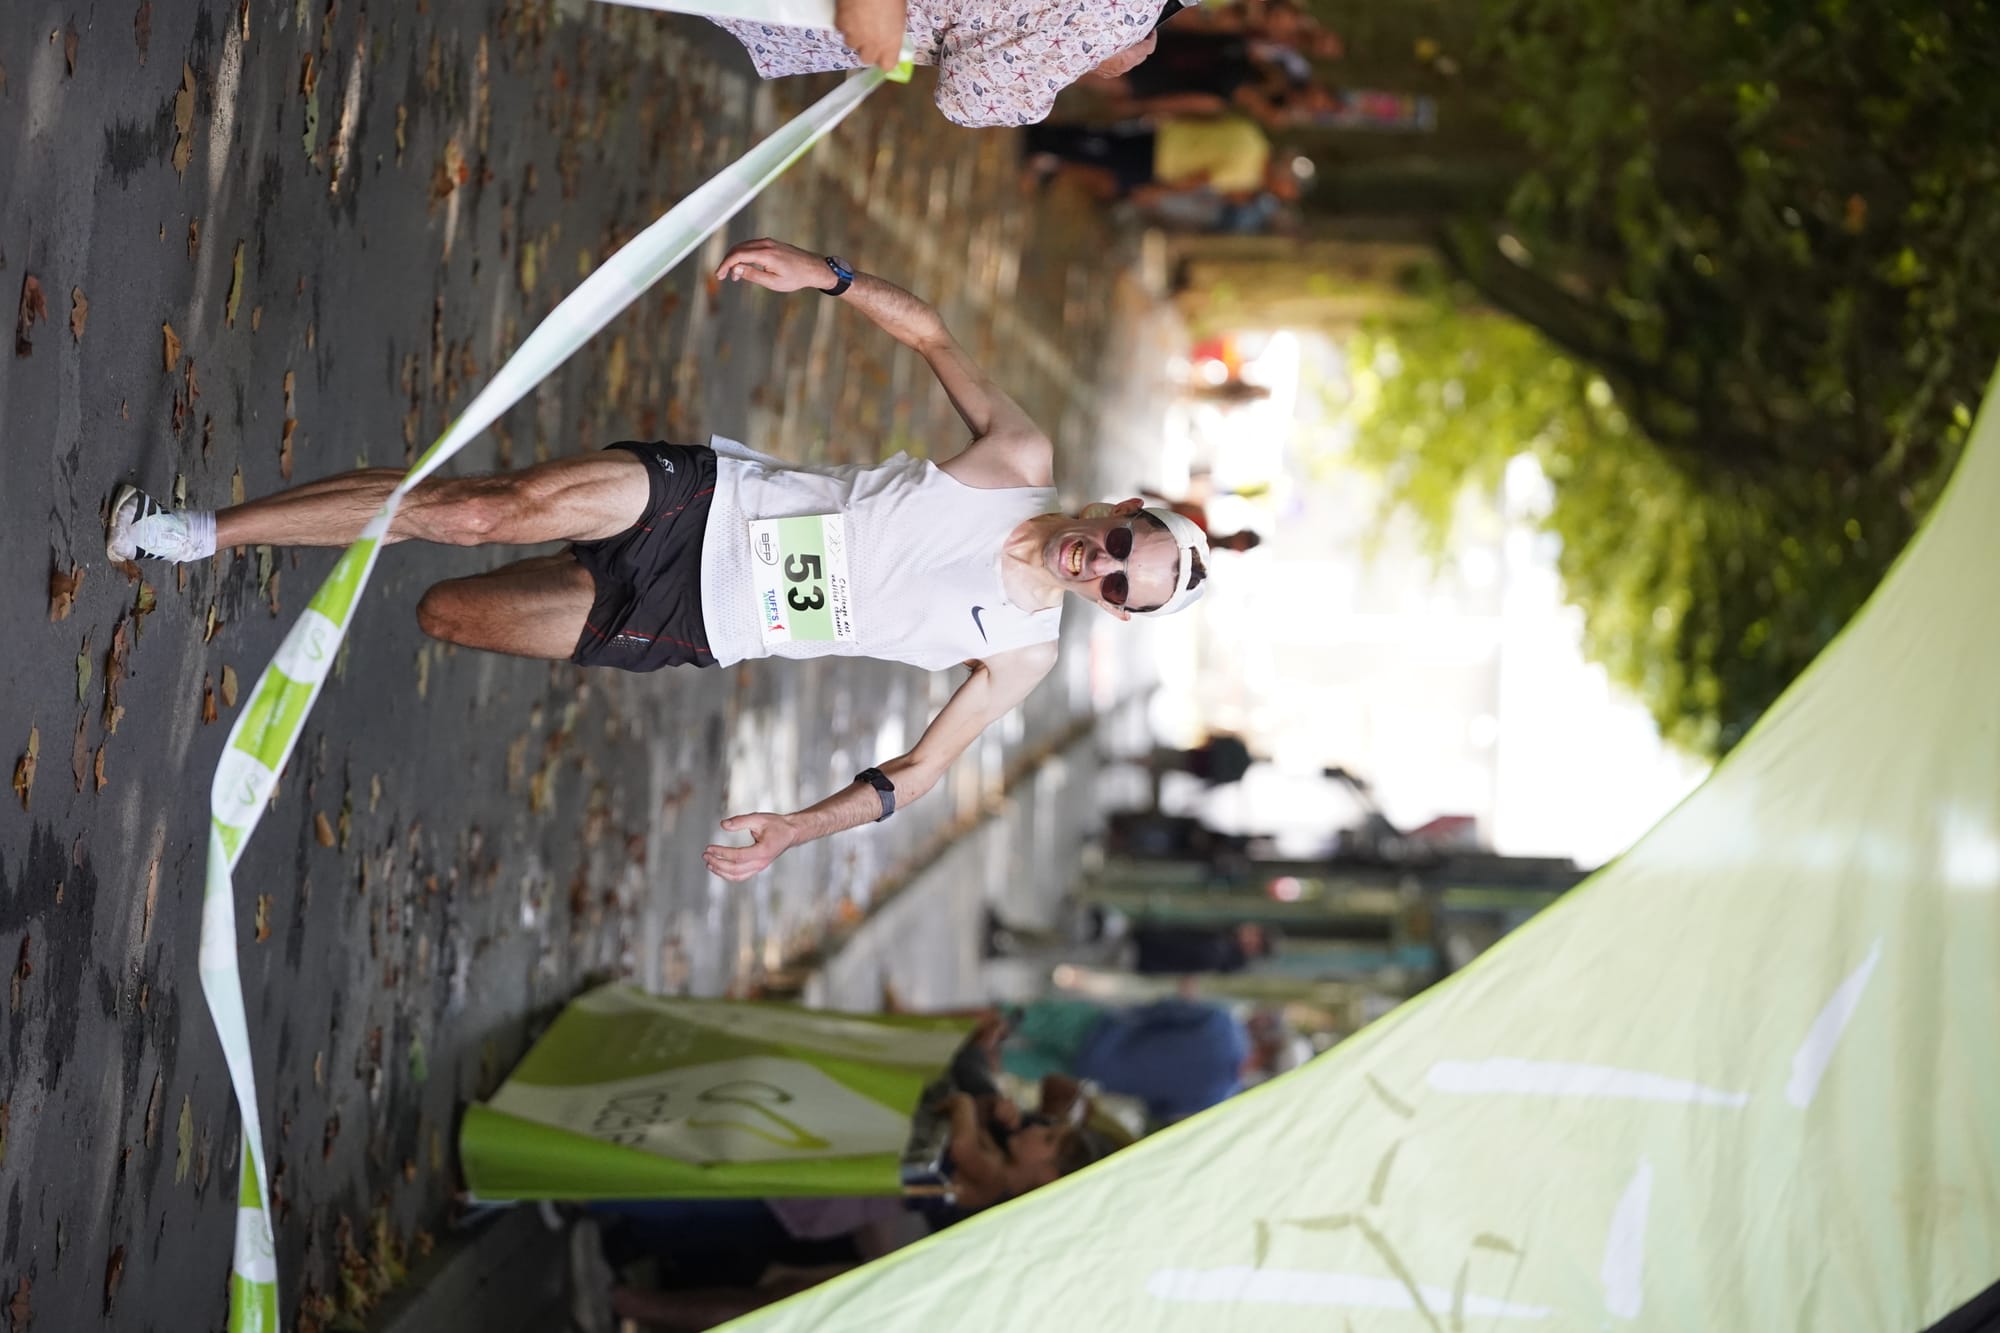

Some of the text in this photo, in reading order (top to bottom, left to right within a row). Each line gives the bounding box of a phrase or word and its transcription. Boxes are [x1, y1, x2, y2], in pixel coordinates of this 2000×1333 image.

[762, 533, 771, 561] BFP
[784, 553, 824, 611] 53
[838, 578, 848, 617] Challenge
[767, 589, 779, 621] TUFF'S
